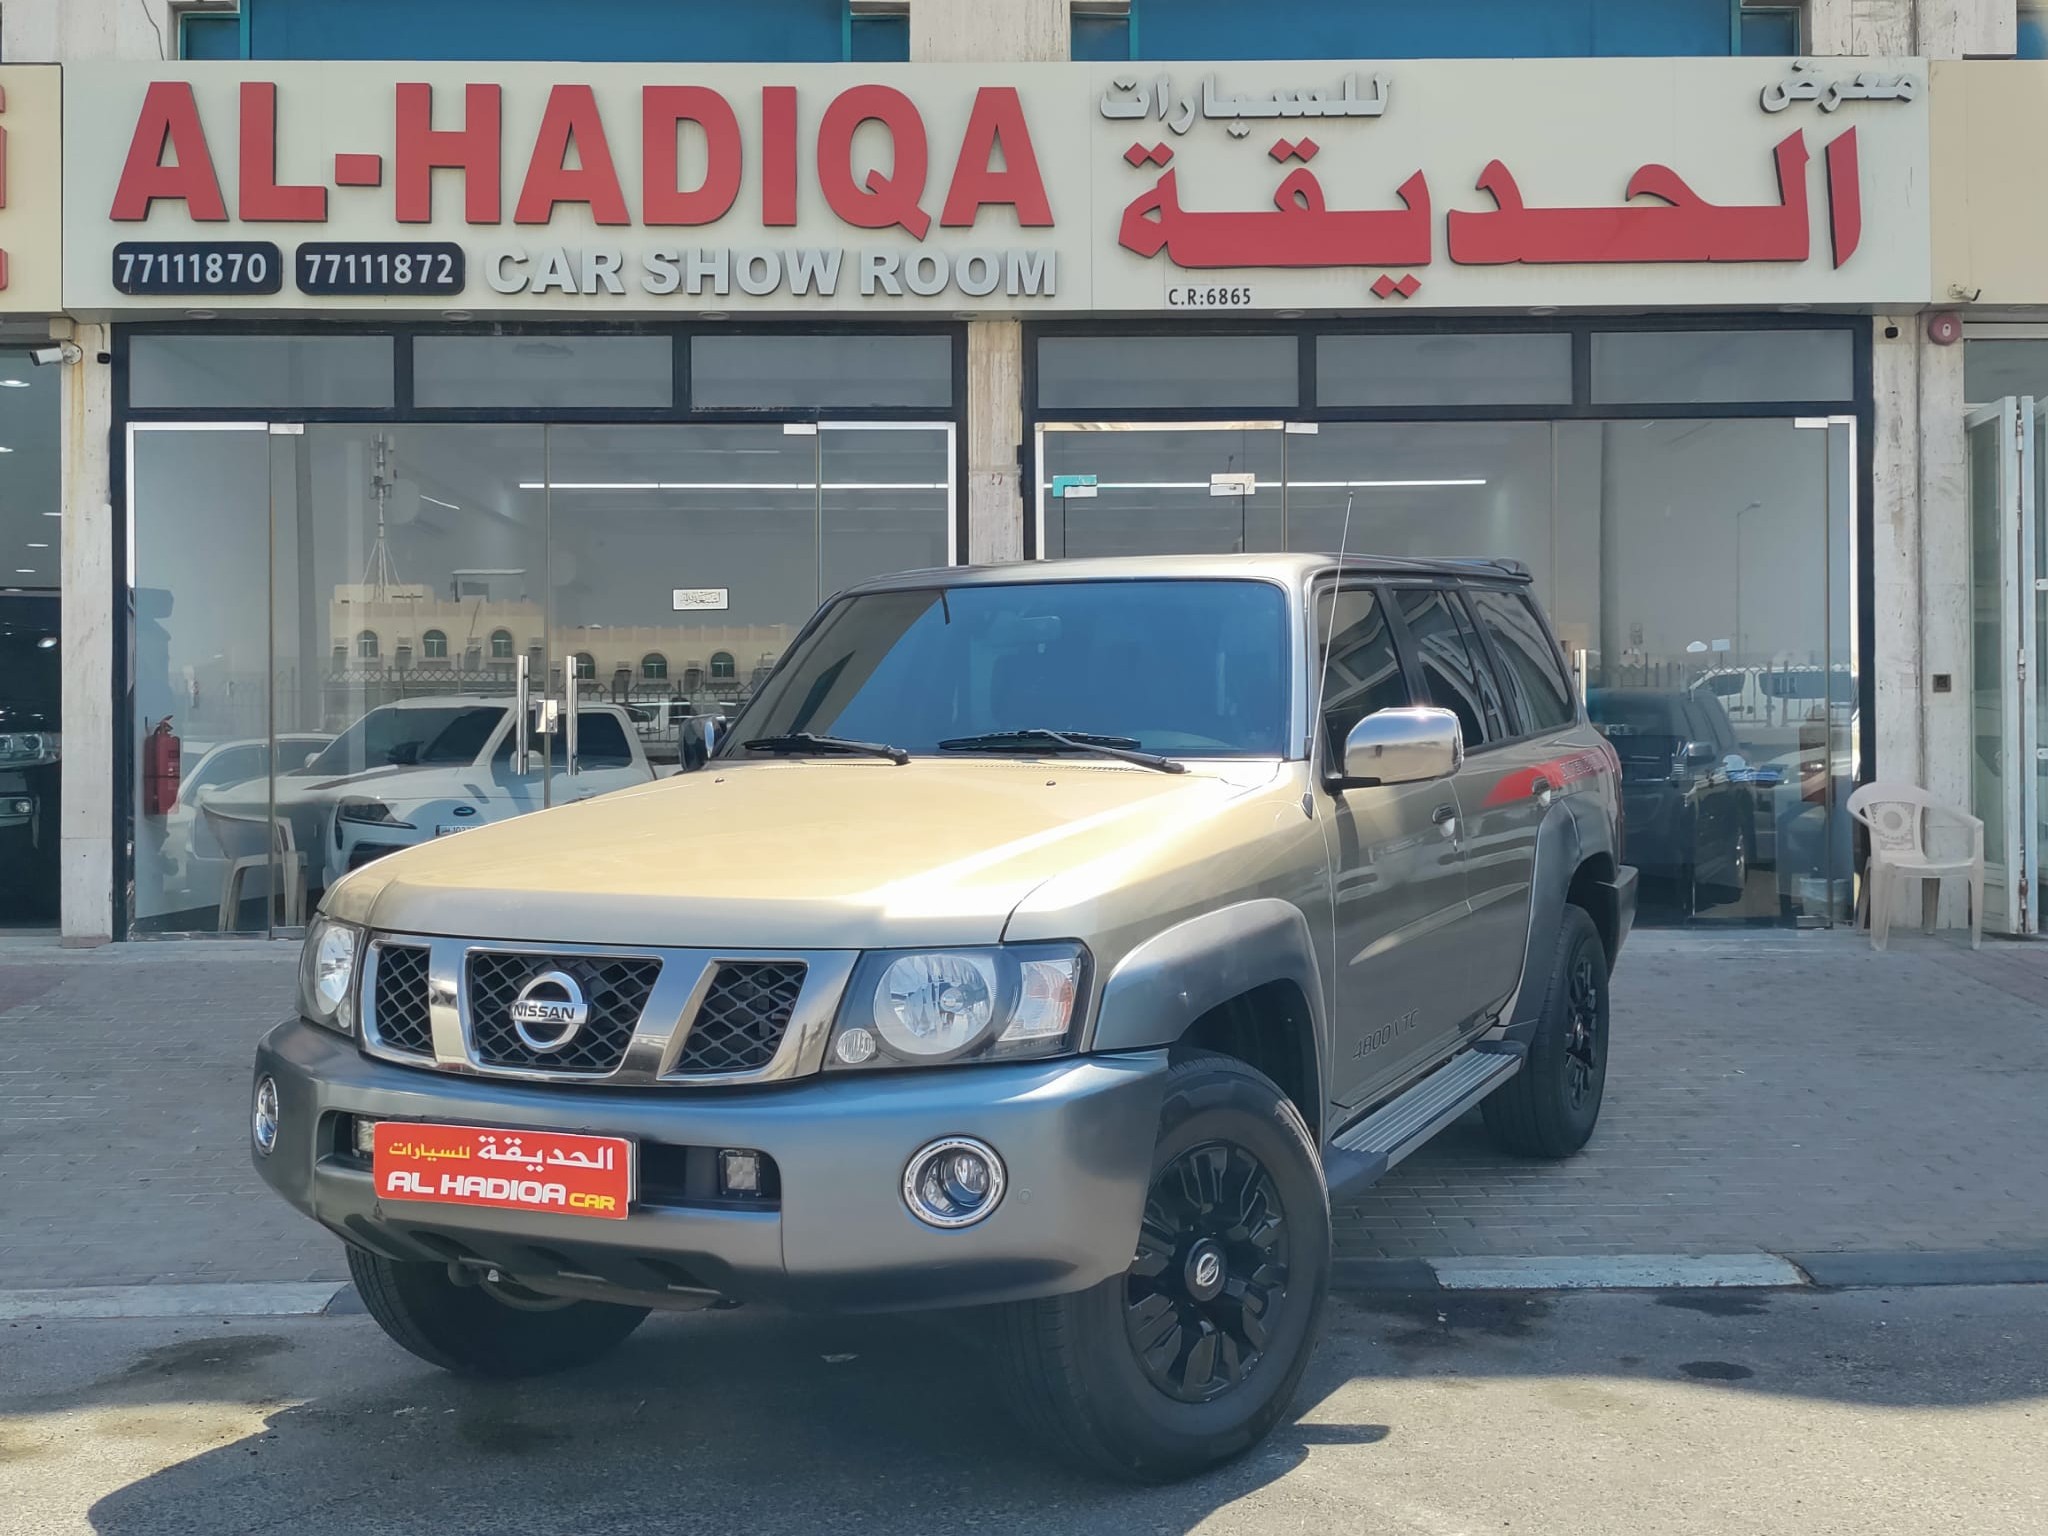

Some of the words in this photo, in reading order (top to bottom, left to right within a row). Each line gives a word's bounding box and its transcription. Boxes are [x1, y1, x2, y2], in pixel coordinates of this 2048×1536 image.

[1100, 72, 1389, 139] للسيارات
[1760, 60, 1918, 113] معرض
[109, 81, 1055, 241] AL-HADIQA
[1118, 125, 1863, 299] الحديقة
[118, 252, 268, 284] 77111870
[304, 252, 455, 285] 77111872
[485, 247, 626, 296] CAR
[639, 246, 845, 296] SHOW
[859, 246, 1057, 296] ROOM
[1168, 288, 1251, 306] C.R:6865
[513, 1003, 576, 1020] NISSAN
[1352, 1023, 1391, 1060] 4800
[388, 1142, 471, 1162] للسيارات
[477, 1134, 614, 1173] الحديقة
[386, 1170, 435, 1195] AL
[440, 1174, 567, 1206] HADIQA
[569, 1192, 616, 1212] CAR
